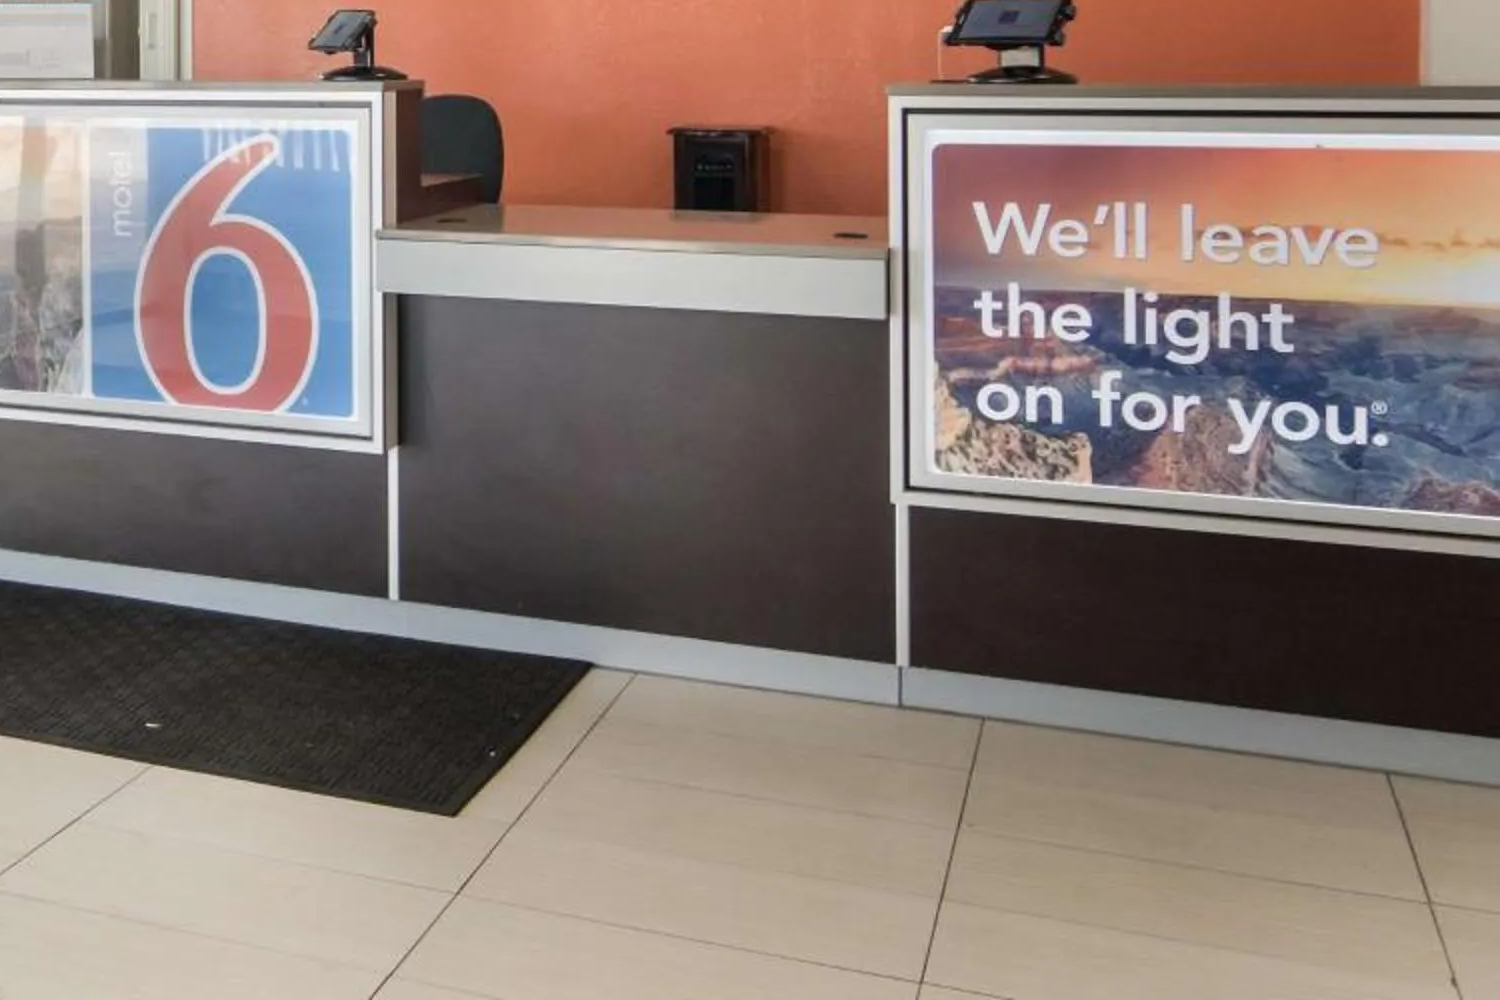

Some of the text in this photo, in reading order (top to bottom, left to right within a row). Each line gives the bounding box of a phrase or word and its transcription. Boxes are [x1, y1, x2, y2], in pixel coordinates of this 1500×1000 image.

[1180, 203, 1380, 268] leave
[109, 132, 320, 414] motel 6
[973, 283, 1296, 365] the light
[976, 383, 1064, 425] on
[1091, 371, 1201, 433] for
